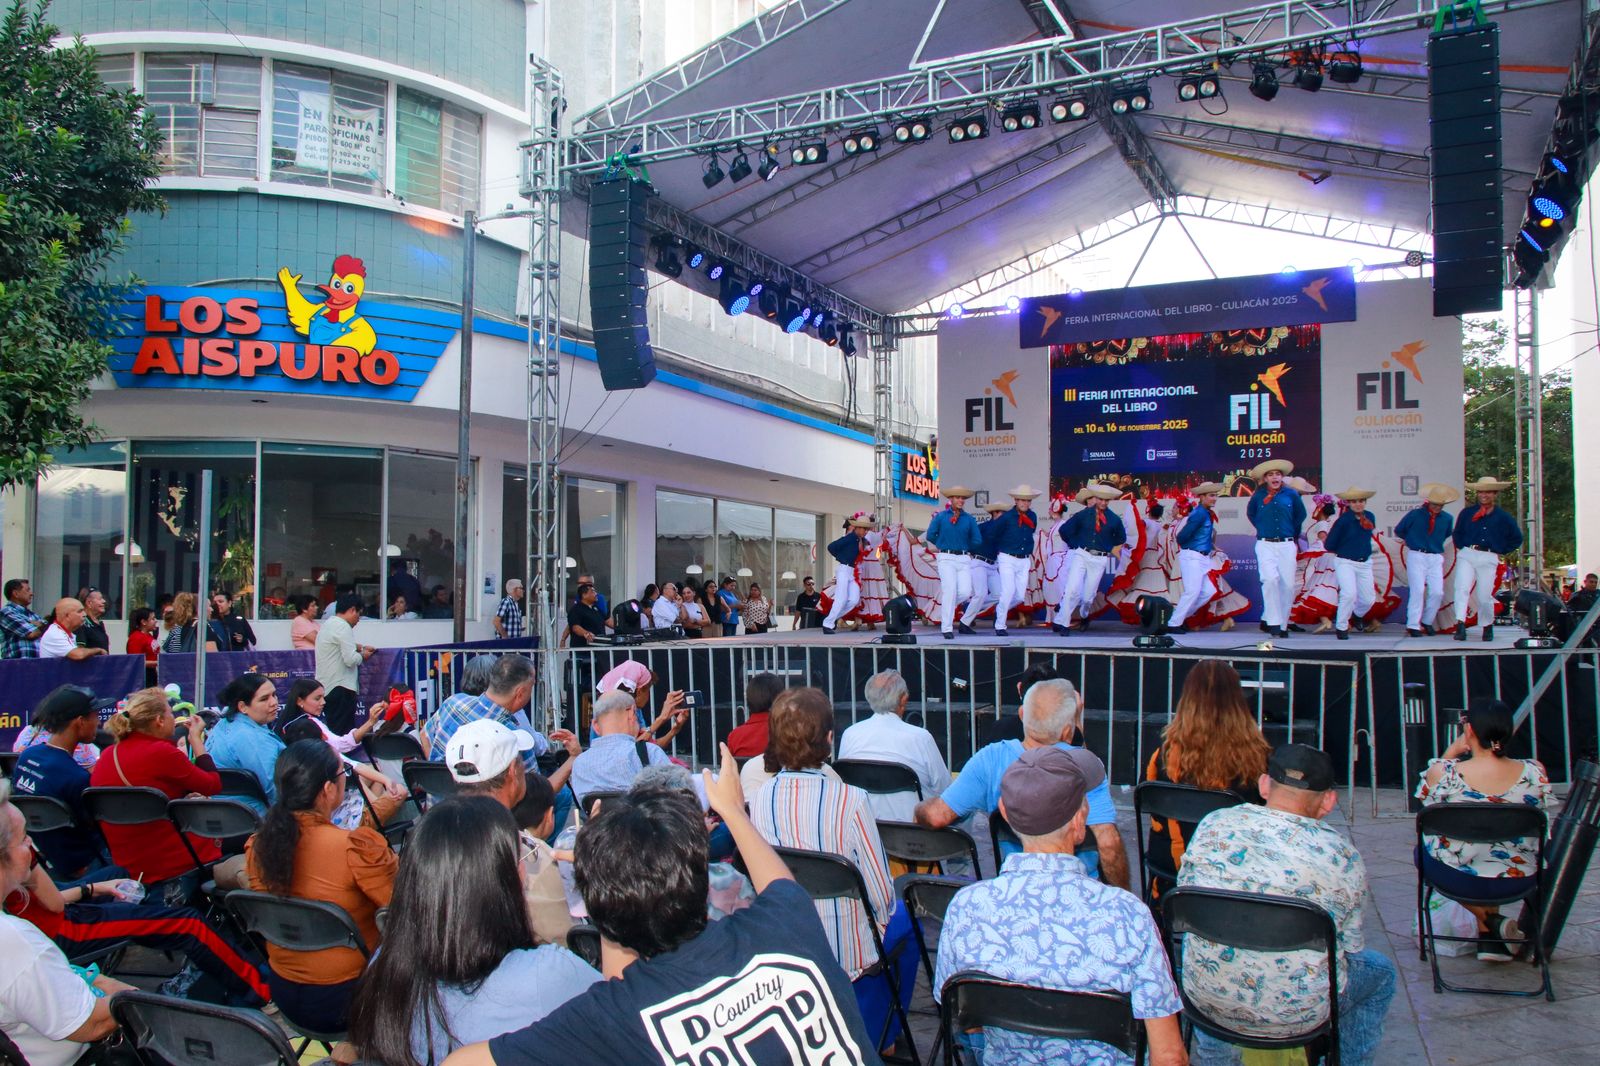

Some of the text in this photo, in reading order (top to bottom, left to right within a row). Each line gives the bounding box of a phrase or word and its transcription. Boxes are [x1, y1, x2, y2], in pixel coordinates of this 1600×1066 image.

[303, 107, 374, 132] EN RENTA
[304, 123, 371, 143] PARA OFICINAS
[145, 295, 262, 335] LOS
[1065, 316, 1089, 325] FERIA
[1092, 309, 1162, 323] INTERNACIONAL
[1165, 306, 1183, 316] DEL
[1185, 303, 1213, 314] LIBRO
[1222, 297, 1269, 311] CULIACÁN
[1272, 295, 1298, 306] 2025
[131, 337, 401, 386] AISPURO
[1064, 385, 1199, 401] III FERIA INTERNACIONAL
[1357, 361, 1419, 411] FIL
[965, 387, 1014, 433] FIL
[1102, 402, 1158, 414] DEL LIBRO
[1230, 383, 1281, 431] FIL
[1354, 411, 1423, 427] CULIACÁN
[1085, 423, 1097, 433] 10
[1106, 422, 1117, 433] 16
[1162, 419, 1189, 431] 2025
[1226, 430, 1286, 446] CULIACÁN
[963, 433, 1017, 447] CULIACÁN
[906, 452, 927, 476] LOS
[1240, 447, 1272, 459] 2025
[904, 473, 940, 499] AISPUR
[713, 974, 784, 1028] Country
